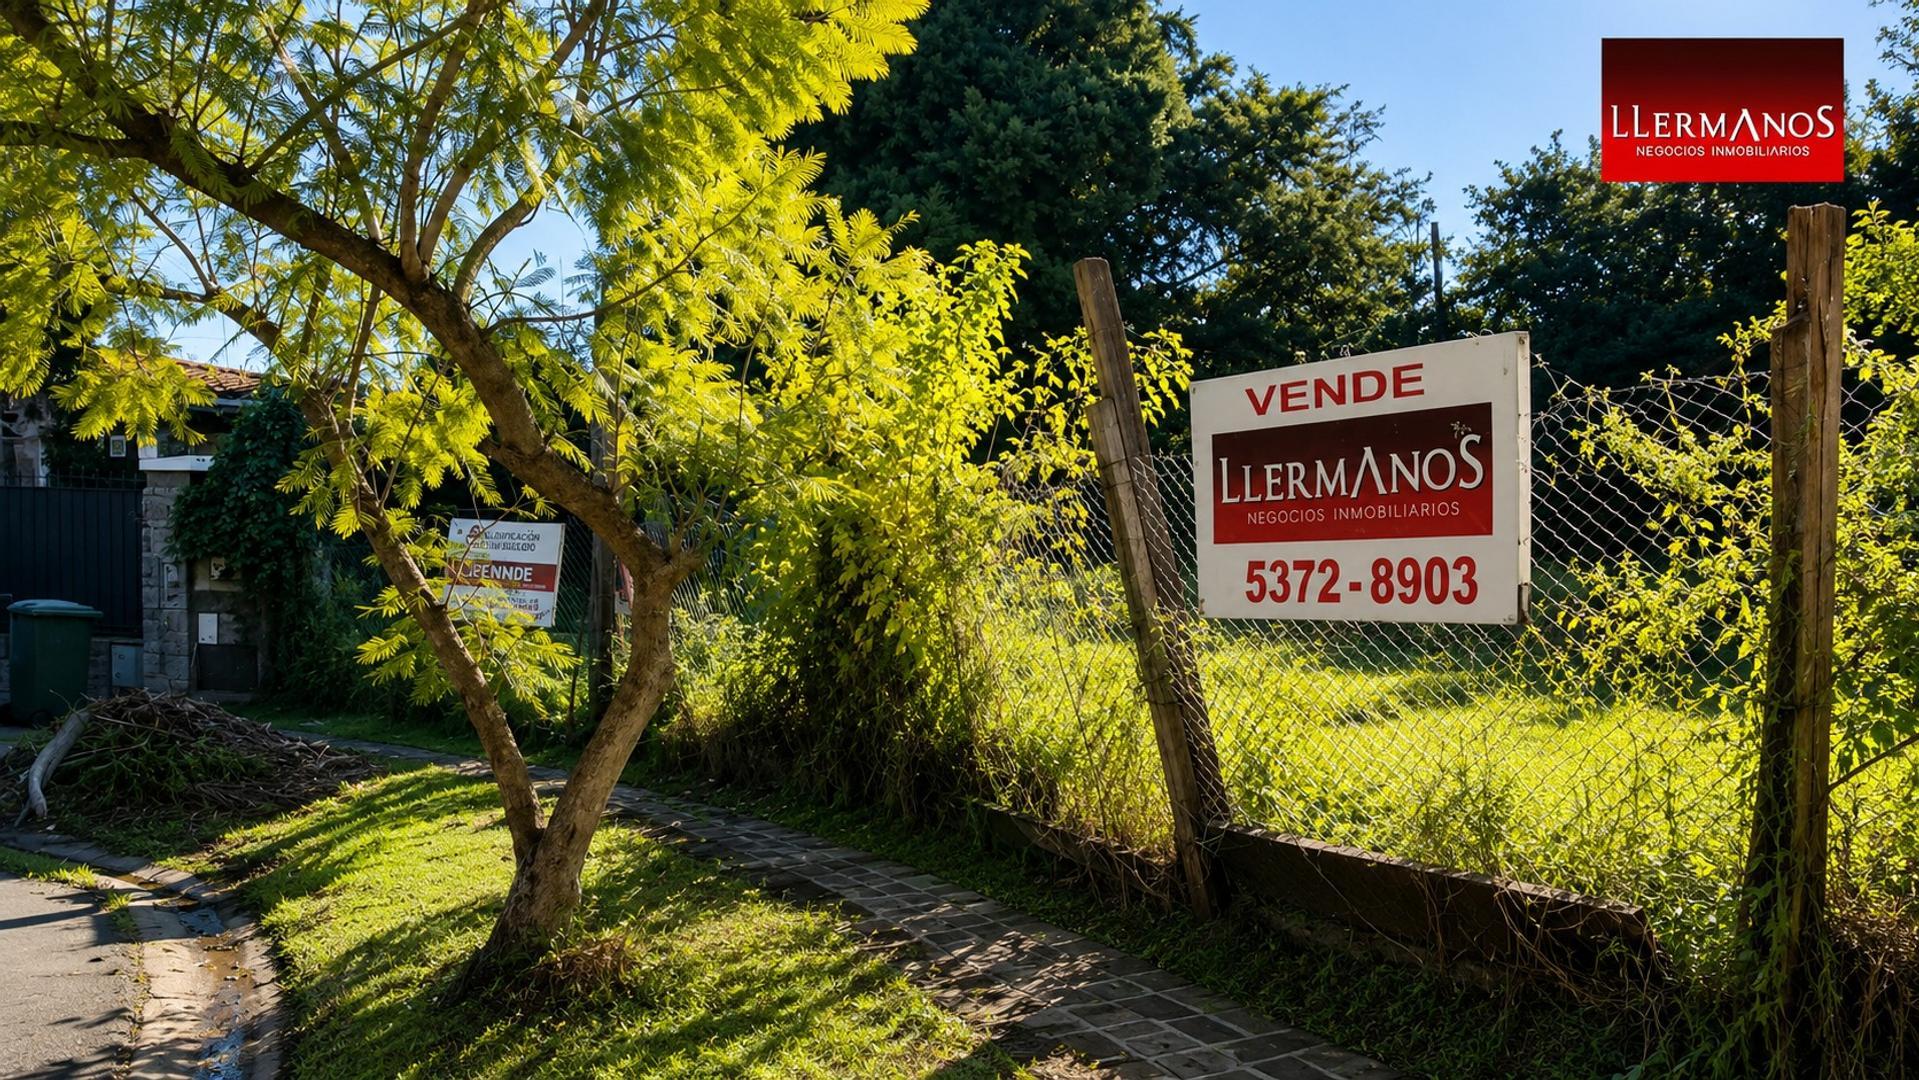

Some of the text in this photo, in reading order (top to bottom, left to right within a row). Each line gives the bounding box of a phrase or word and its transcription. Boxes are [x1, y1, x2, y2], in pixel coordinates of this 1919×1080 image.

[1245, 362, 1426, 416] VENDE
[1219, 433, 1485, 504] LLERMANOS
[1247, 501, 1460, 525] NEGOCIOS INMOBILIARIOS
